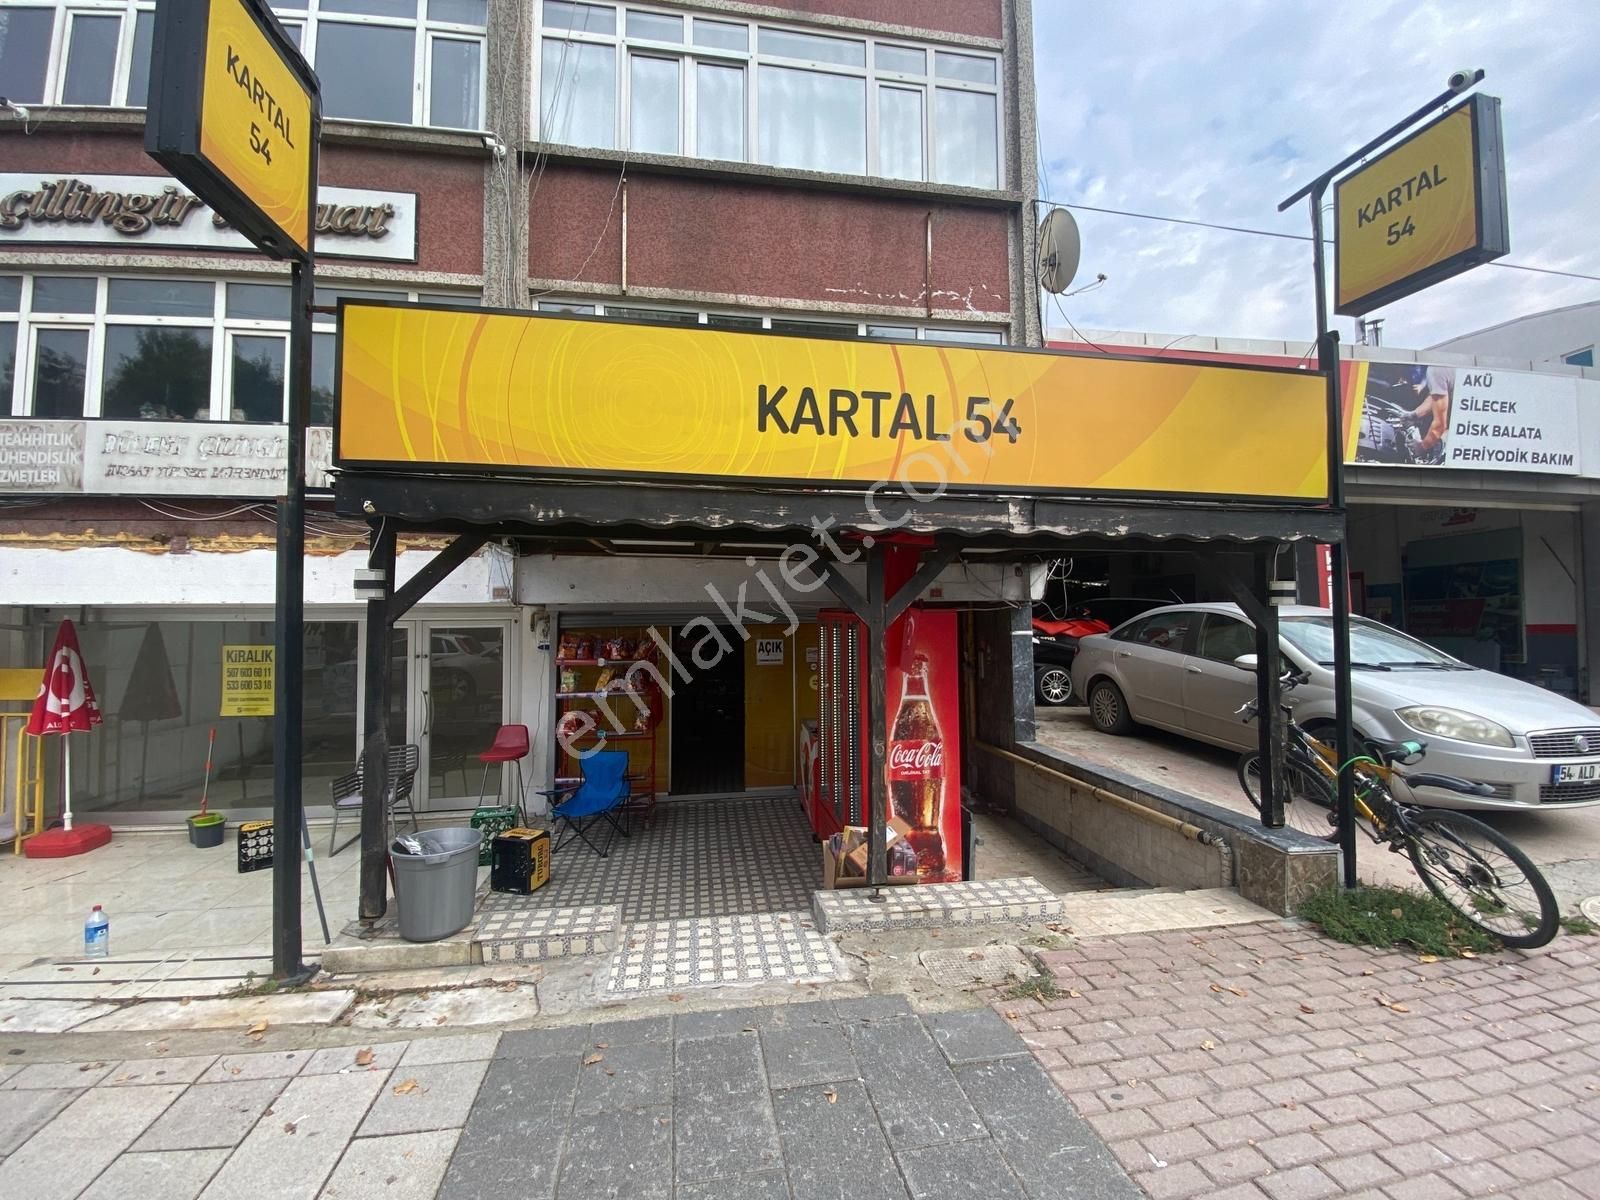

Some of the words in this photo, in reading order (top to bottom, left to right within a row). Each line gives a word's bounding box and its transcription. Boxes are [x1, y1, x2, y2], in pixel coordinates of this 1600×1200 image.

[227, 45, 294, 150] KARTAL
[250, 121, 271, 166] 54
[1358, 164, 1447, 228] KARTAL
[1387, 215, 1415, 246] 54
[1463, 373, 1492, 388] AKÜ
[757, 384, 951, 442] KARTAL
[963, 396, 1021, 444] 54
[1459, 397, 1517, 413] SİLECEK
[1456, 421, 1488, 437] DİSK
[1492, 425, 1542, 440] BALATA
[1452, 446, 1529, 463] PERİYODİK
[1531, 452, 1573, 466] BAKIM
[758, 641, 782, 656] AÇIK
[890, 742, 943, 769] Coca-Cola
[1560, 766, 1573, 780] 54
